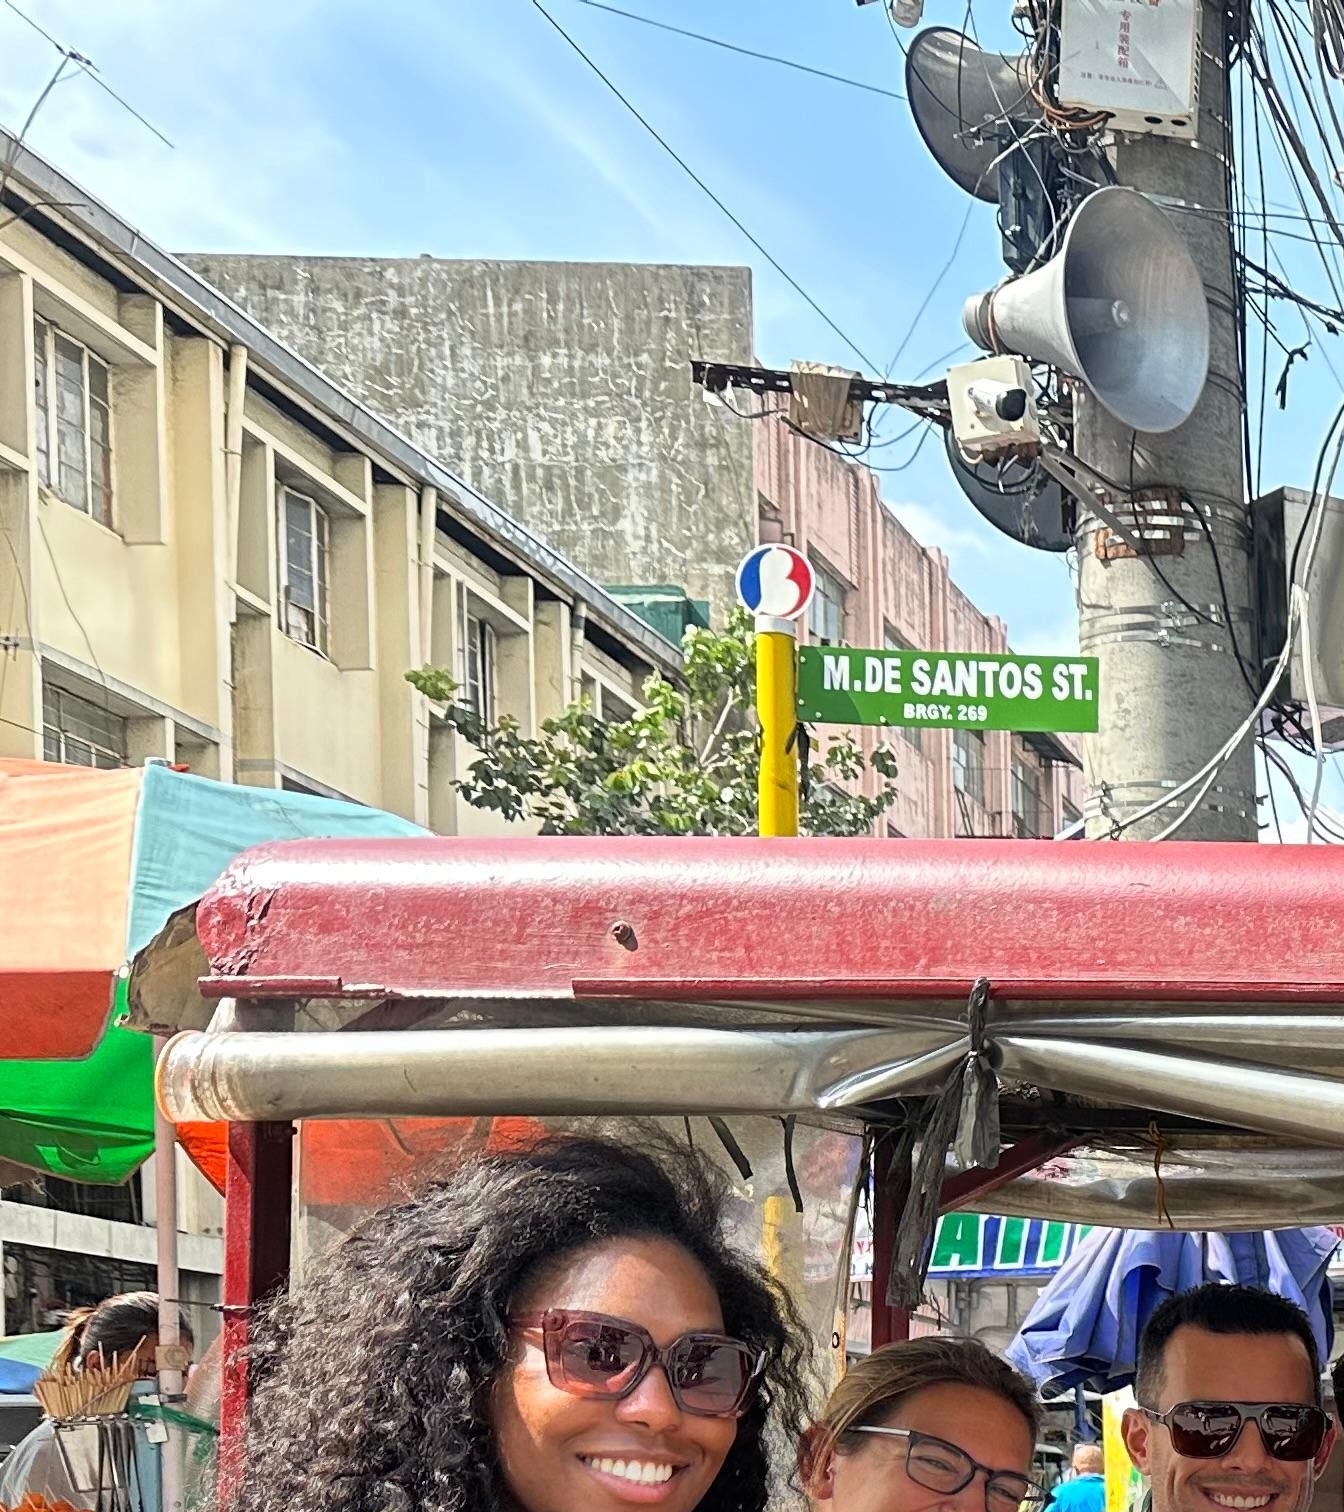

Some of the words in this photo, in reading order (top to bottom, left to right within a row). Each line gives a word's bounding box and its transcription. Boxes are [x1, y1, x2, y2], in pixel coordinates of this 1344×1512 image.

[910, 657, 1044, 700] SANTOS
[1051, 662, 1094, 701] ST.
[902, 702, 953, 721] BRGY.
[956, 703, 988, 722] 269
